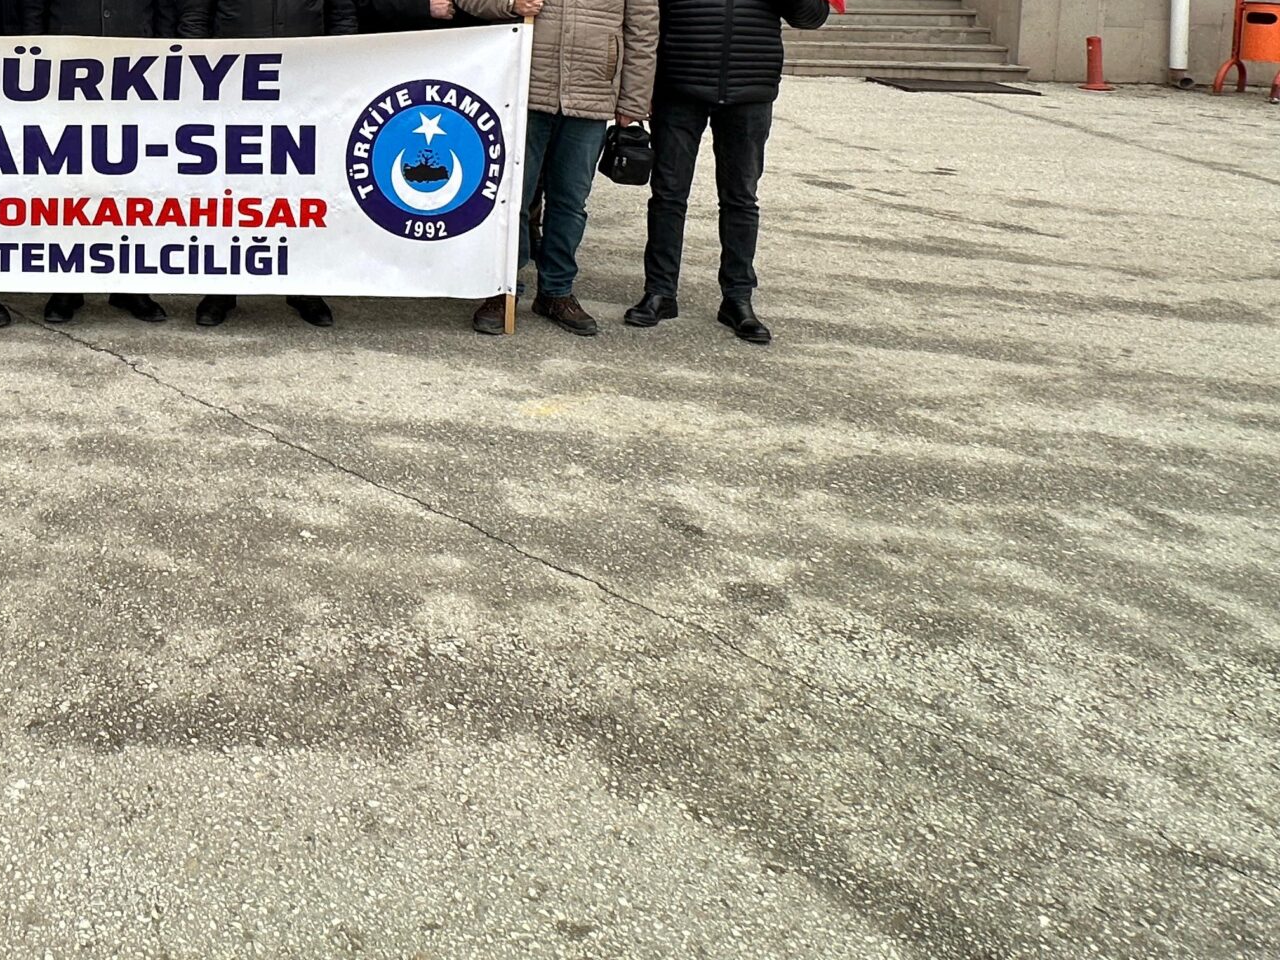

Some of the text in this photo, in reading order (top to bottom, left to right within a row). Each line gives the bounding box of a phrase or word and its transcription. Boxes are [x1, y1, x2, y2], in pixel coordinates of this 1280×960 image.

[349, 84, 501, 201] TÜRKİYE KAMU-SEN
[404, 219, 448, 239] 1992
